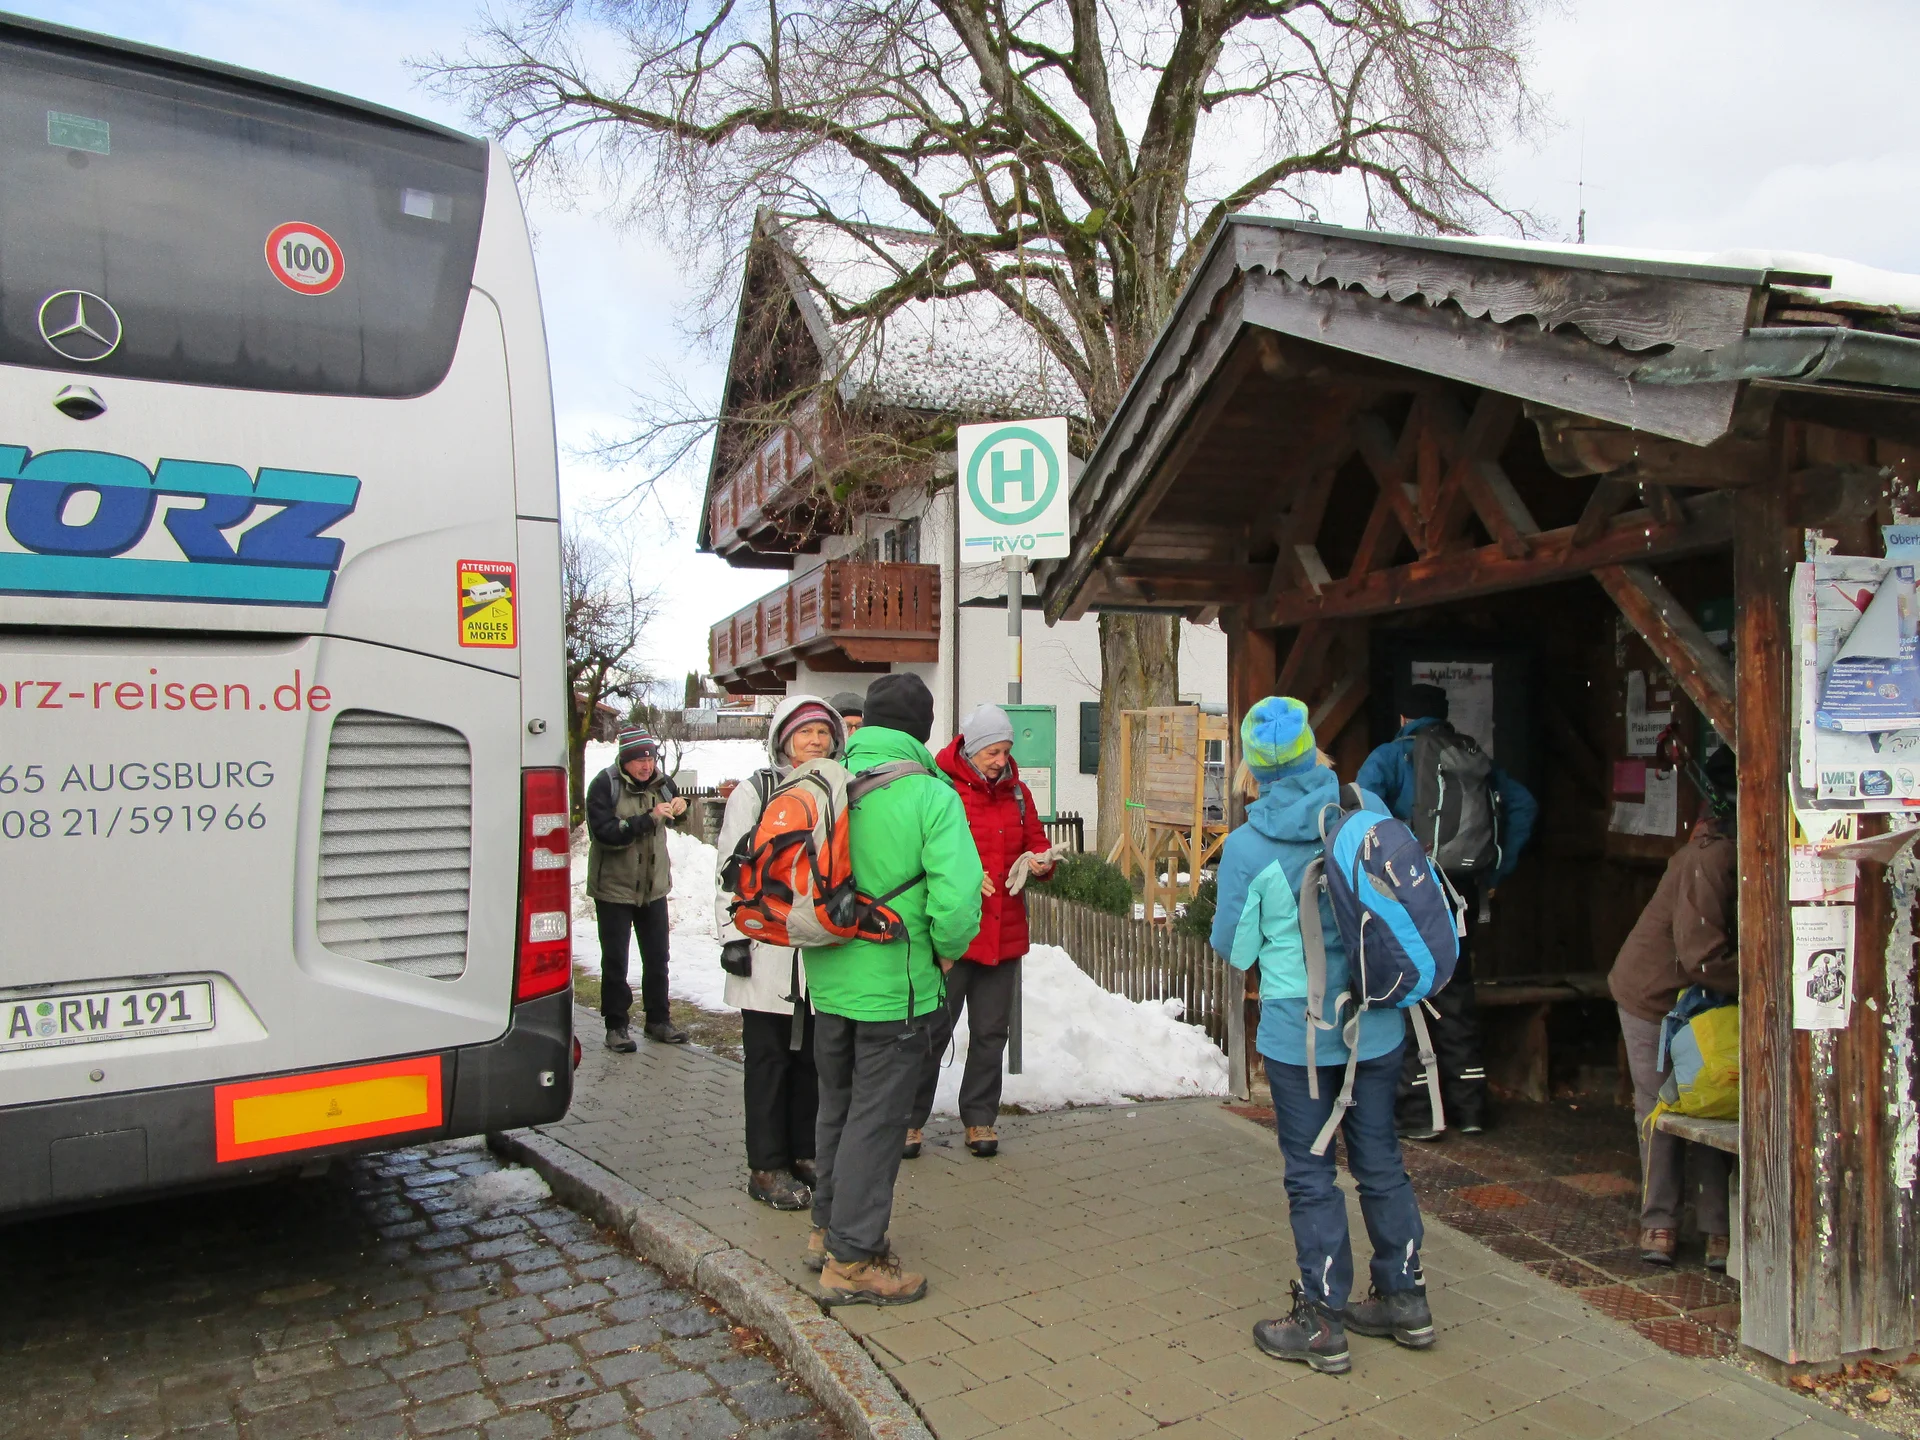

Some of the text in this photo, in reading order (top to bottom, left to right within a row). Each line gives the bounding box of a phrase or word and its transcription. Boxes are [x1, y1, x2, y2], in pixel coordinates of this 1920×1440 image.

[283, 241, 330, 274] 100
[991, 448, 1035, 504] H
[993, 534, 1036, 553] RVO
[461, 563, 512, 573] ATTENTION
[467, 622, 509, 632] ANGLES
[470, 631, 507, 640] MORTS
[60, 761, 275, 791] AUGSBURG
[1821, 772, 1845, 784] LVM
[9, 990, 191, 1039] A RW 191
